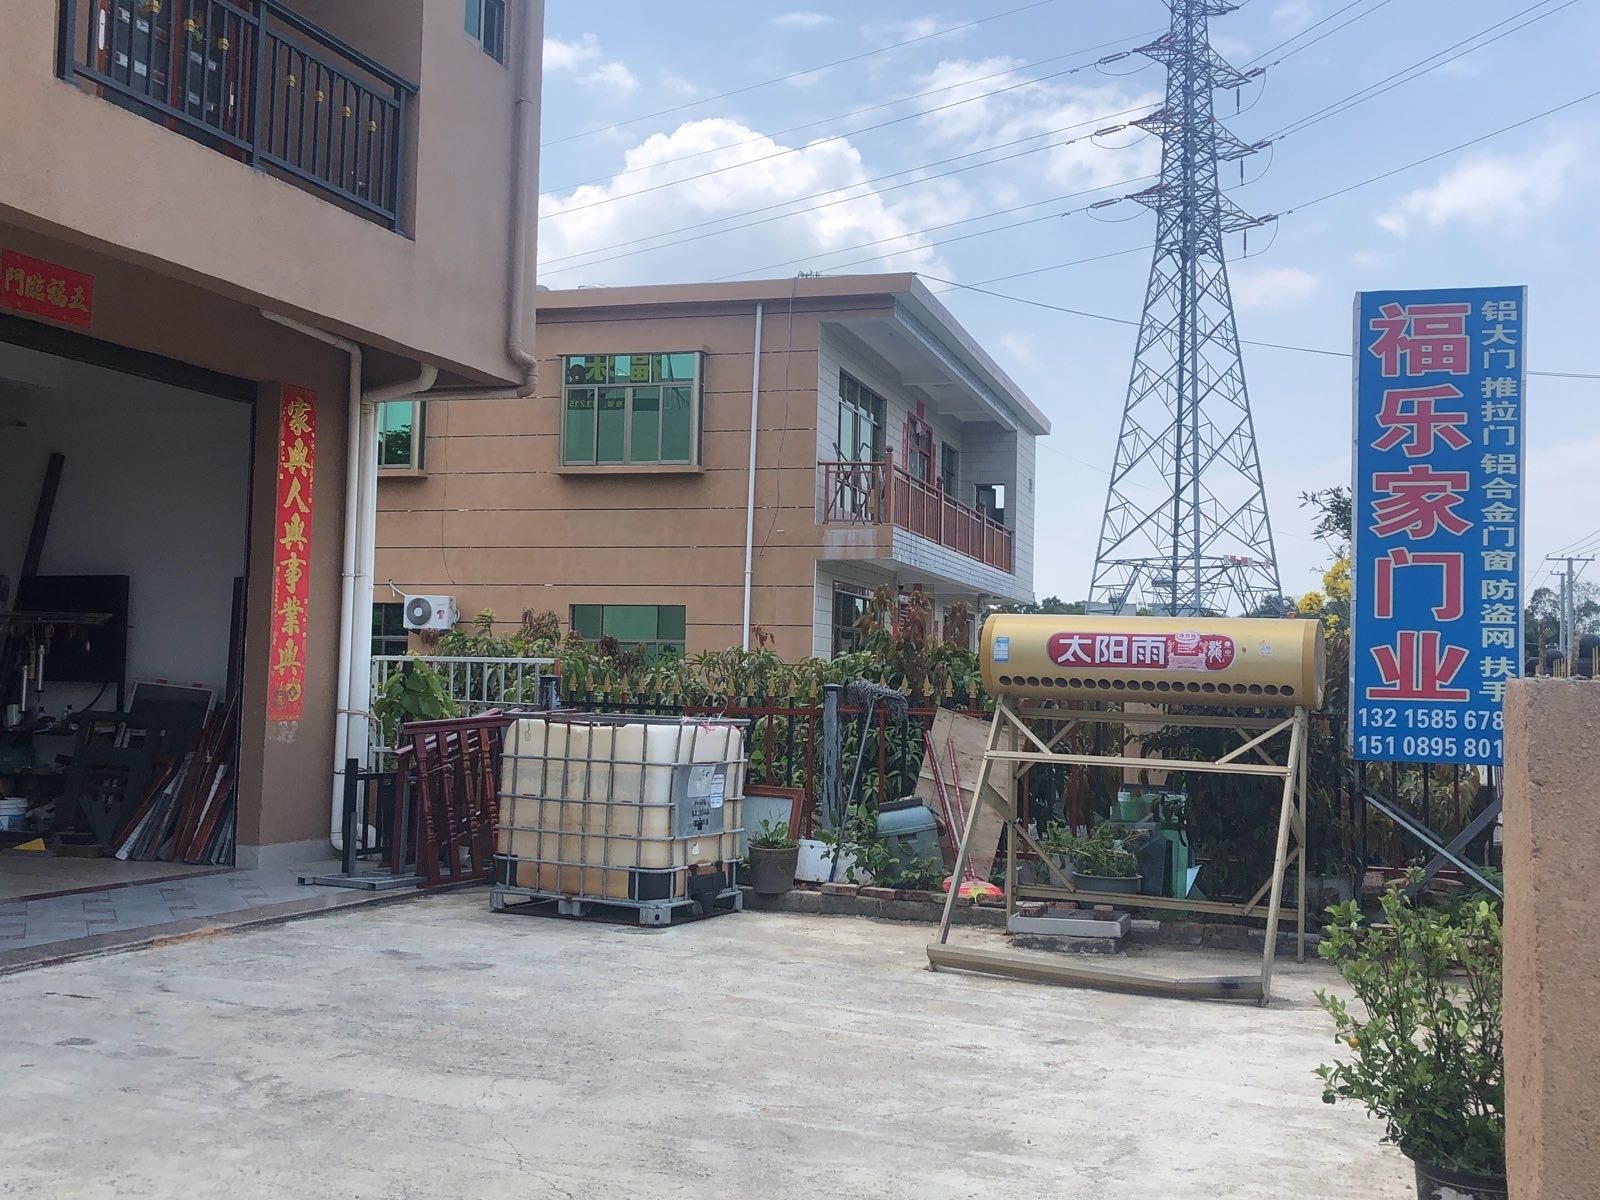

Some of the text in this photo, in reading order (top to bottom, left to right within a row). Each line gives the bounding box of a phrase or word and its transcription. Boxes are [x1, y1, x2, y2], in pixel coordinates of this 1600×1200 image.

[1481, 300, 1518, 369] 铝大门
[1481, 376, 1518, 446] 推拉门
[1367, 302, 1474, 702] 福乐家门业
[1480, 453, 1518, 571] 铝合金门窗
[1480, 578, 1517, 649] 防盗网
[1057, 635, 1167, 665] 太阳雨
[1358, 708, 1504, 731] 132 1585 678
[1358, 735, 1503, 758] 151 0895 801
